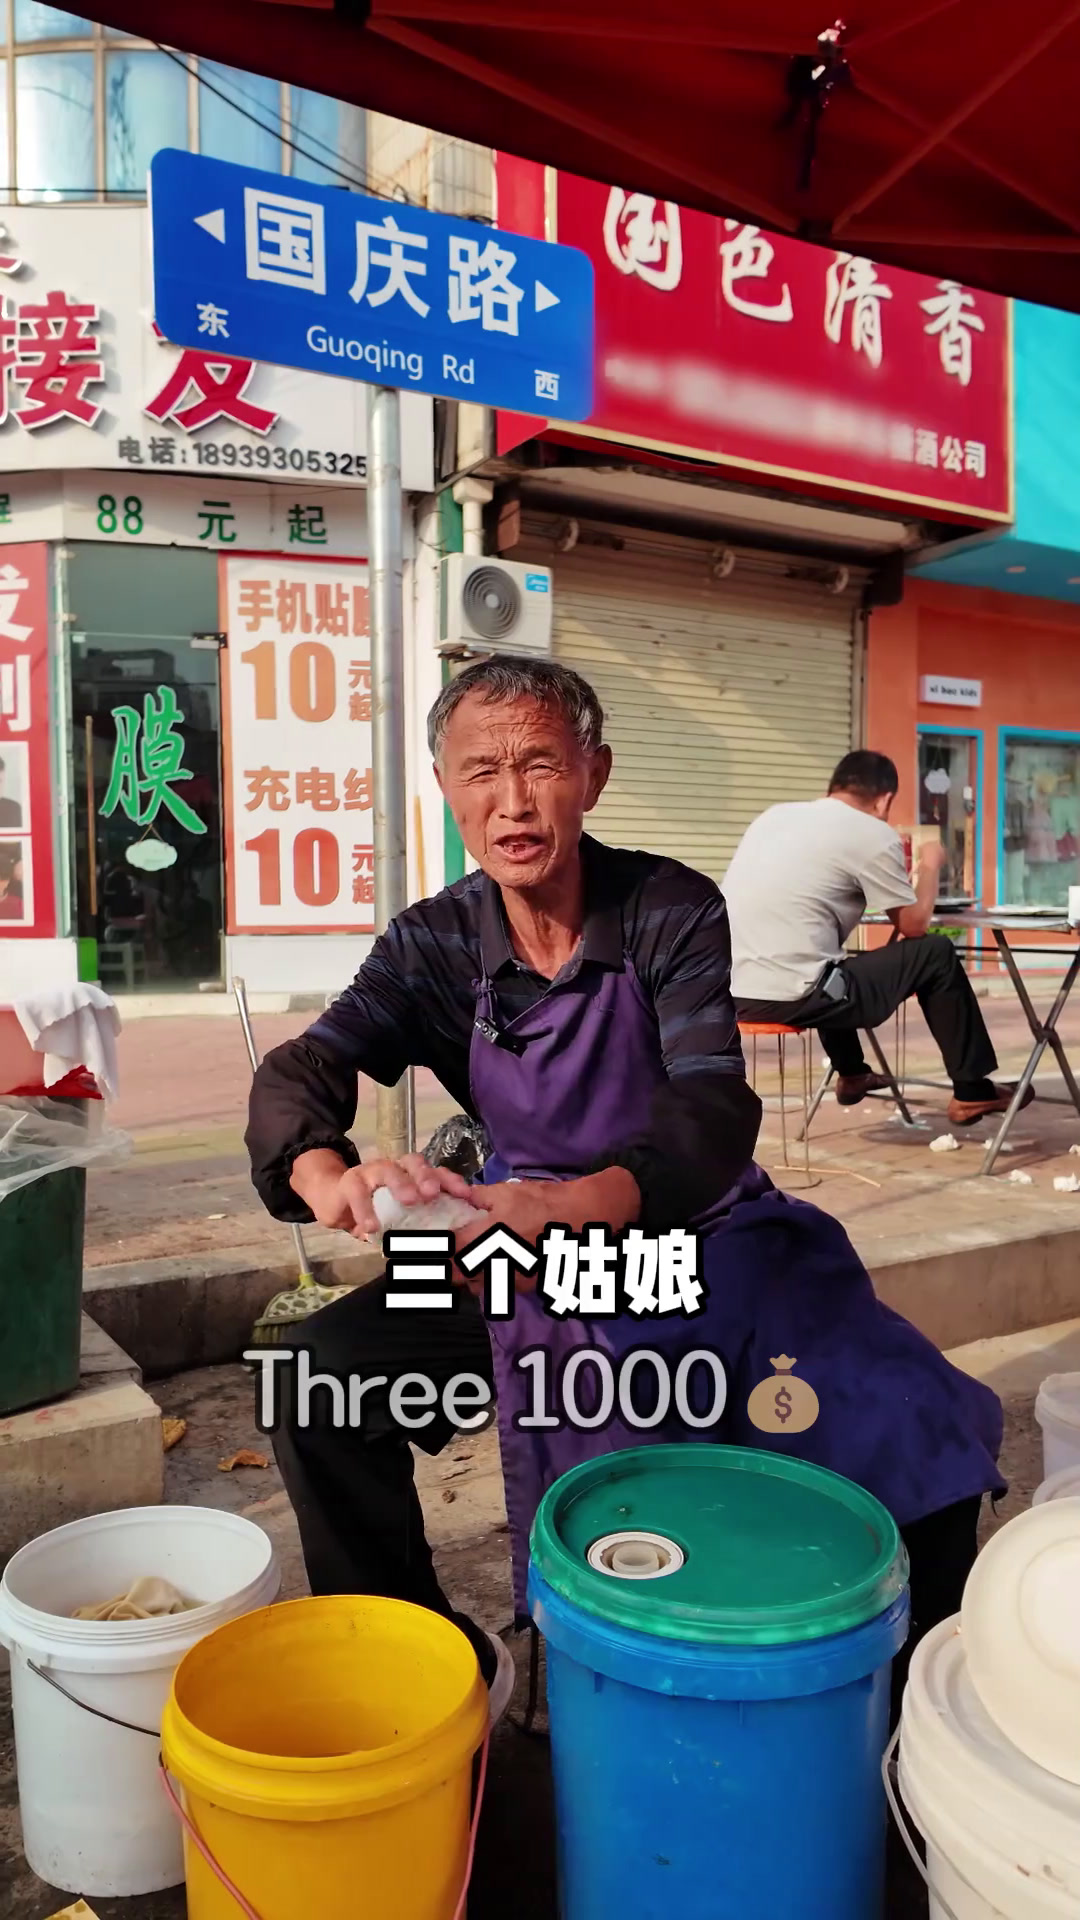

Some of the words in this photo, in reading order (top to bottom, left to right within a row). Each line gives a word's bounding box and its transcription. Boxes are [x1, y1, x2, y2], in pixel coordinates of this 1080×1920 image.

[244, 187, 525, 336] 国庆路
[196, 302, 230, 338] 东
[306, 325, 423, 380] Guoqing
[443, 354, 475, 384] Rd
[534, 369, 561, 400] 西
[240, 641, 336, 723] 10
[98, 685, 207, 834] 膜
[244, 827, 340, 907] 10
